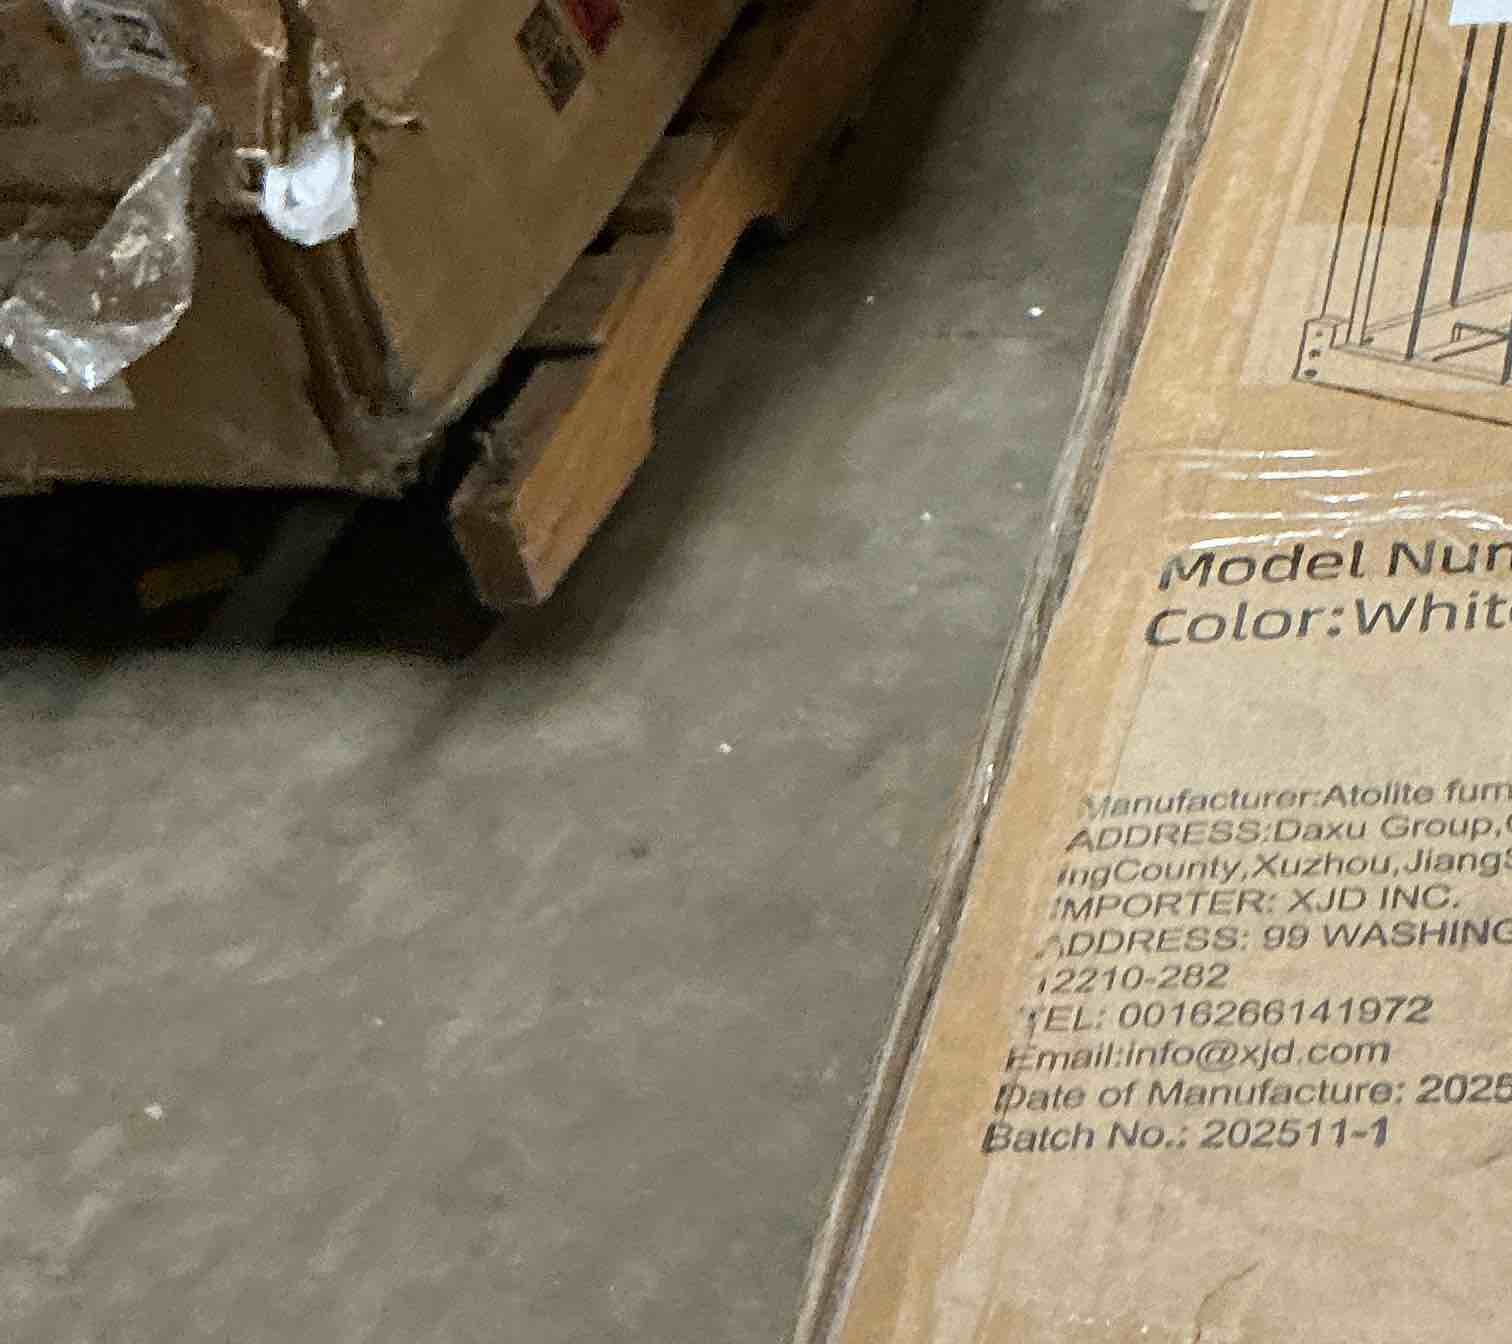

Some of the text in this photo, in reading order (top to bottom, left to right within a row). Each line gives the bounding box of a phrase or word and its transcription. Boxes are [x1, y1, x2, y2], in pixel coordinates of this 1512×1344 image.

[1156, 539, 1365, 592] Model
[1287, 886, 1368, 913] XJD
[1378, 882, 1460, 911] INC.
[1262, 923, 1311, 951] 99
[1019, 993, 1435, 1039] TEL: 0016266141972
[1004, 1037, 1392, 1074] Email:info@xjd.com
[993, 1080, 1087, 1114] Date
[1097, 1079, 1142, 1109] of
[1146, 1075, 1407, 1108] Manufacture:
[980, 1114, 1390, 1155] Batch No.: 202511-1
